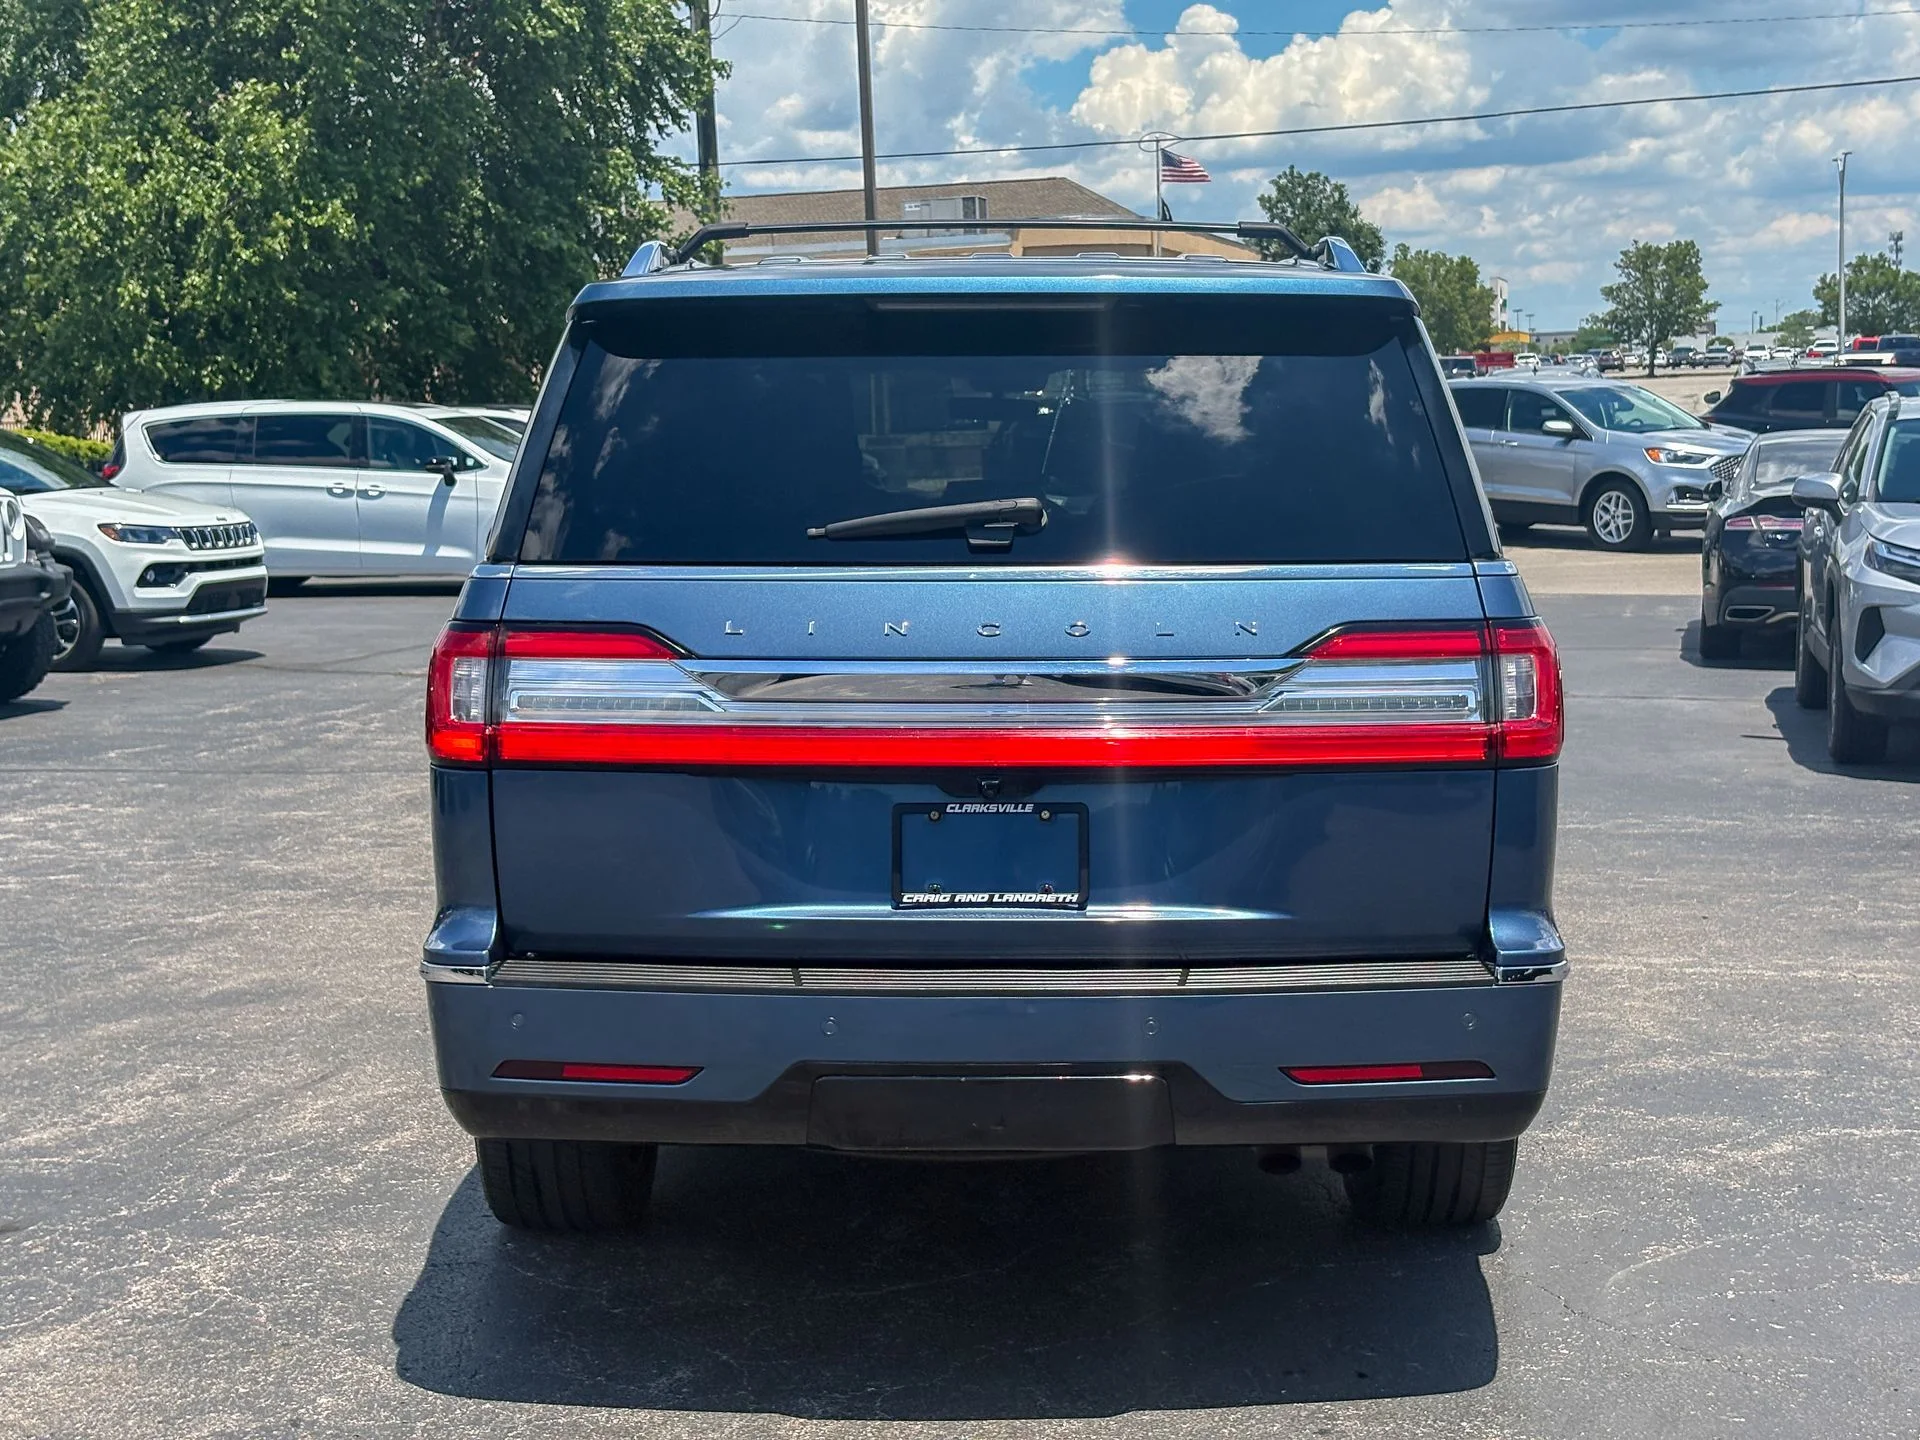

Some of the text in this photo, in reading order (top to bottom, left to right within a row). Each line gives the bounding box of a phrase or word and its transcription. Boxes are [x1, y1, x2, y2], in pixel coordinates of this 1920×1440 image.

[724, 619, 1259, 638] LINCOLN
[946, 803, 1034, 813] CLARKSVILLE
[902, 893, 1079, 903] CRAIG AND LANDRETH
